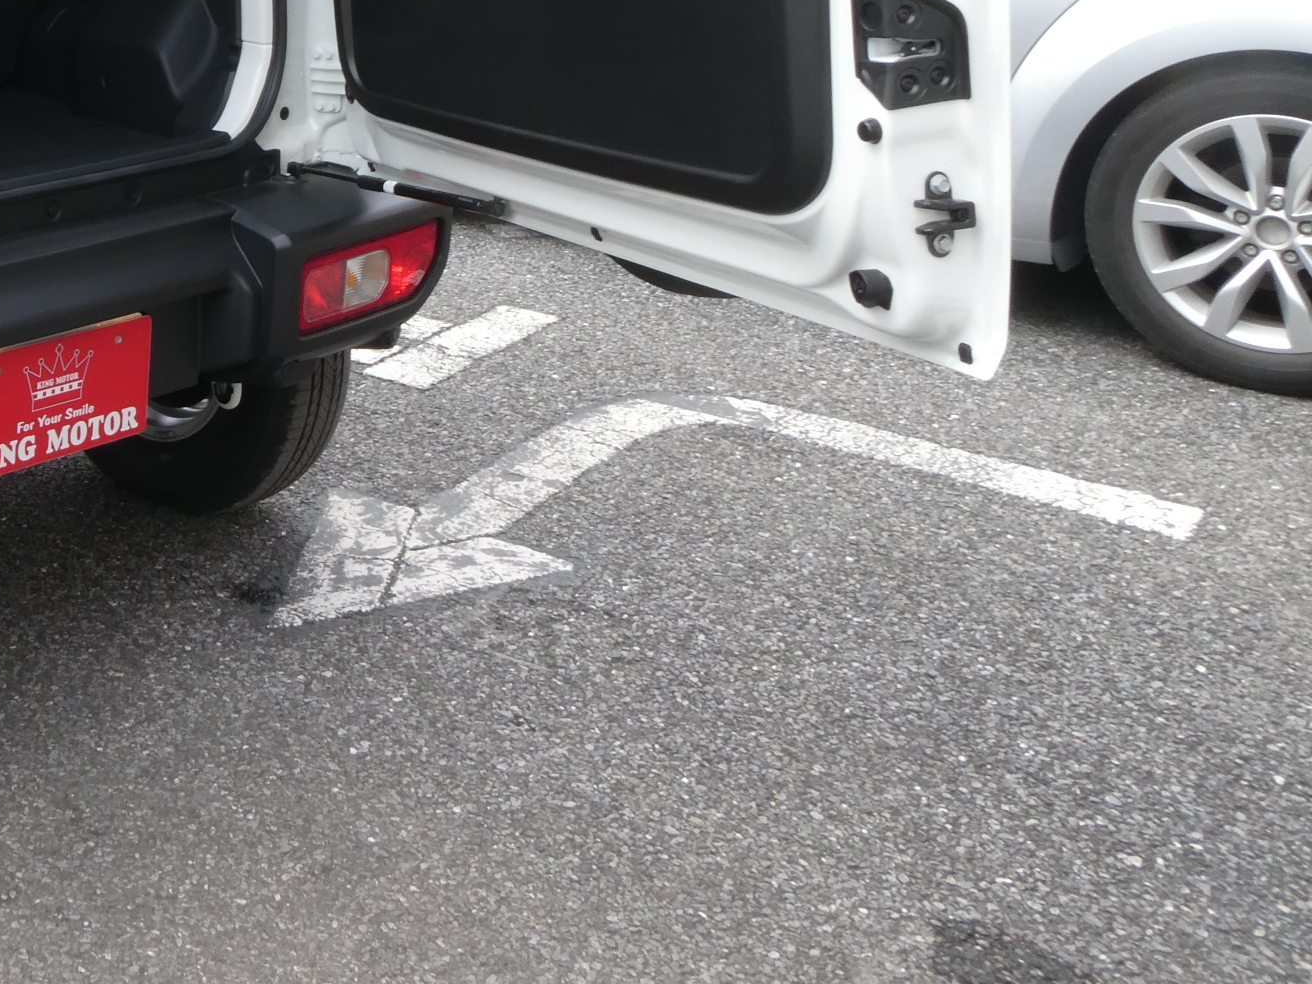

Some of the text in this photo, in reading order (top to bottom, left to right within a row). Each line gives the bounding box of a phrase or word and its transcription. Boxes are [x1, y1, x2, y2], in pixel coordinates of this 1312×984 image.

[36, 371, 79, 390] KING MOTOR
[16, 403, 95, 434] For Your Smile
[46, 406, 139, 455] MOTOR
